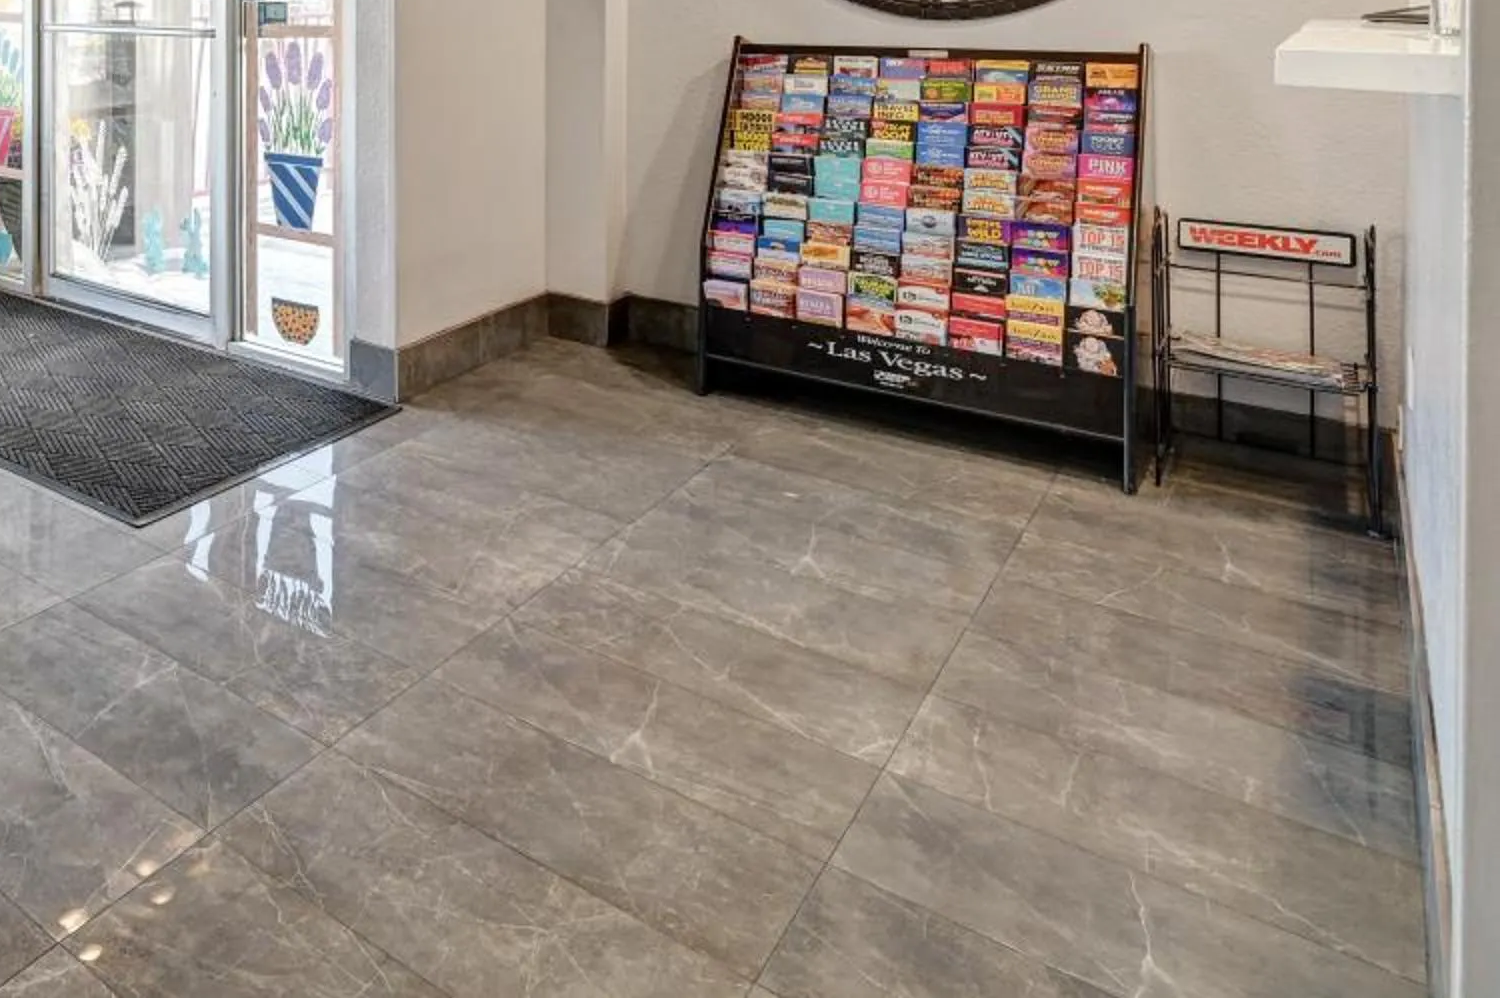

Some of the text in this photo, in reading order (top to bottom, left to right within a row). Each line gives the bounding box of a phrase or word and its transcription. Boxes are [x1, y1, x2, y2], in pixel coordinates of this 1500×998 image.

[1089, 158, 1127, 175] PINK
[1189, 225, 1319, 255] WEEKLY
[826, 340, 872, 363] Las
[876, 348, 964, 381] Vegas
